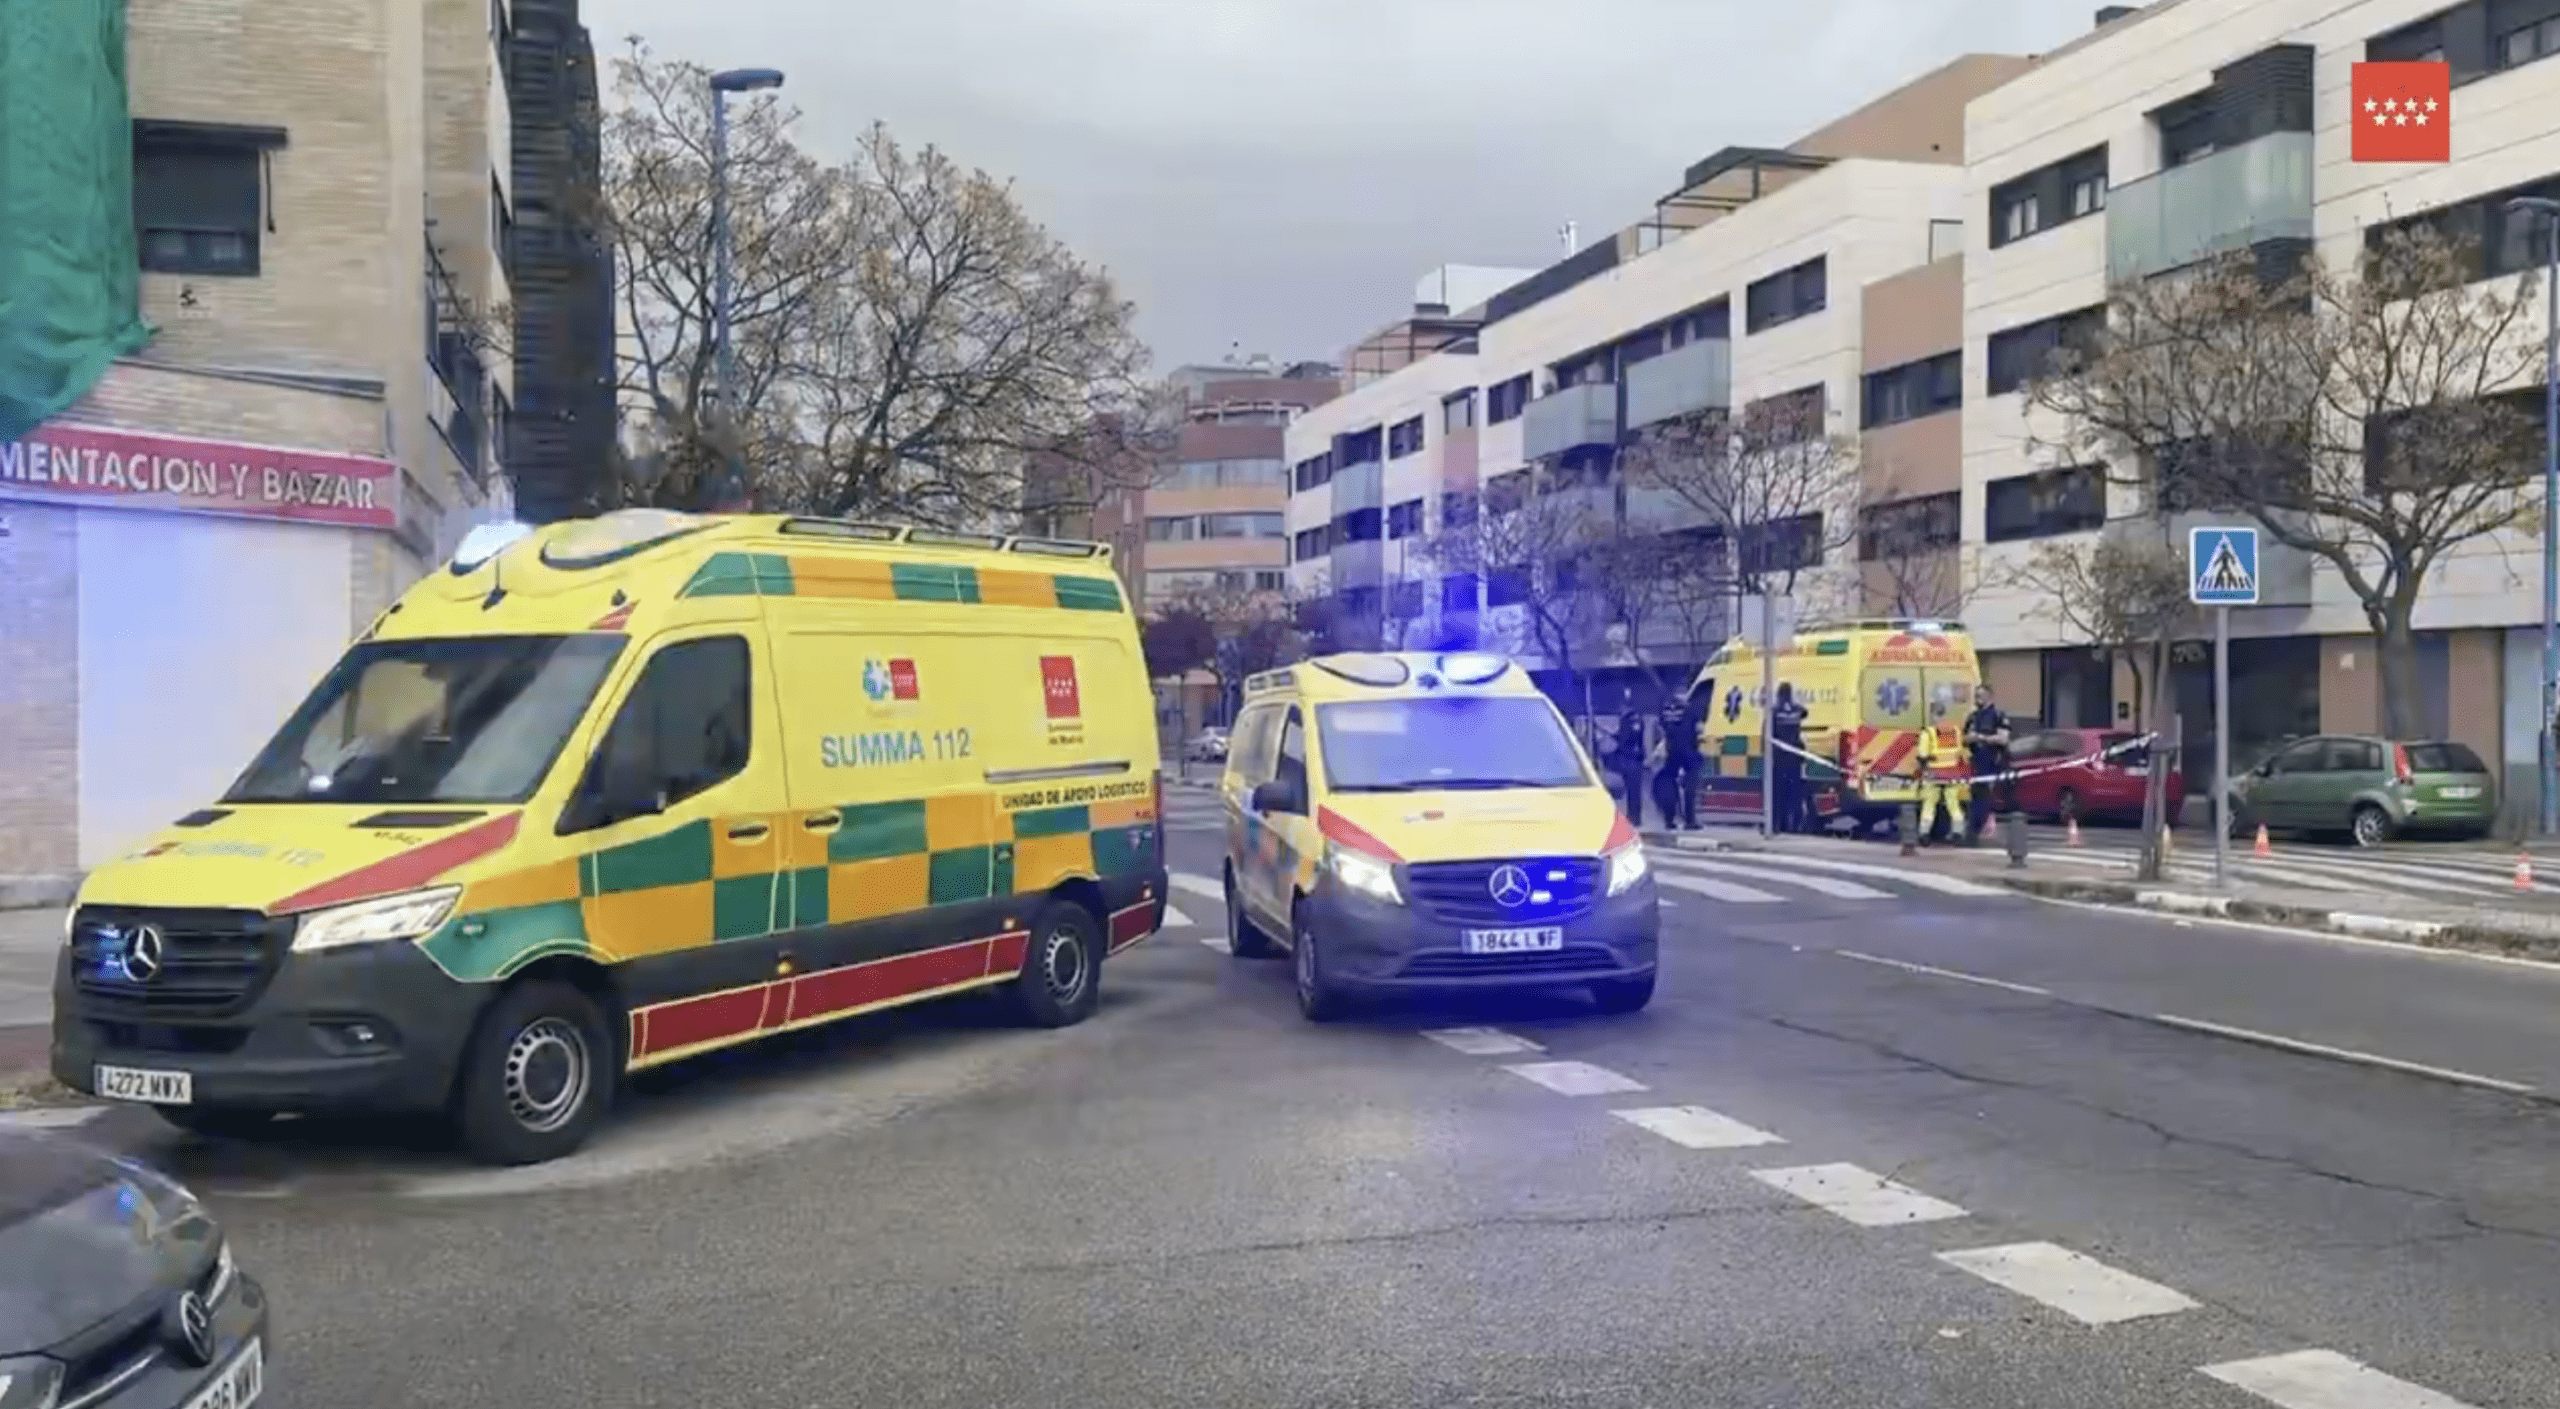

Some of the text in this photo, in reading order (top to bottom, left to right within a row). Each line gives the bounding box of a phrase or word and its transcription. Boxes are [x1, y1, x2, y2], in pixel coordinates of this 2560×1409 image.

[229, 463, 249, 498] Y
[263, 466, 375, 510] BAZAR
[820, 726, 972, 769] SUMMA 112
[1003, 780, 1147, 809] UNIDAD DE APOYO LOGISTICO
[1477, 931, 1520, 952] 1844
[105, 1069, 147, 1097] 4272
